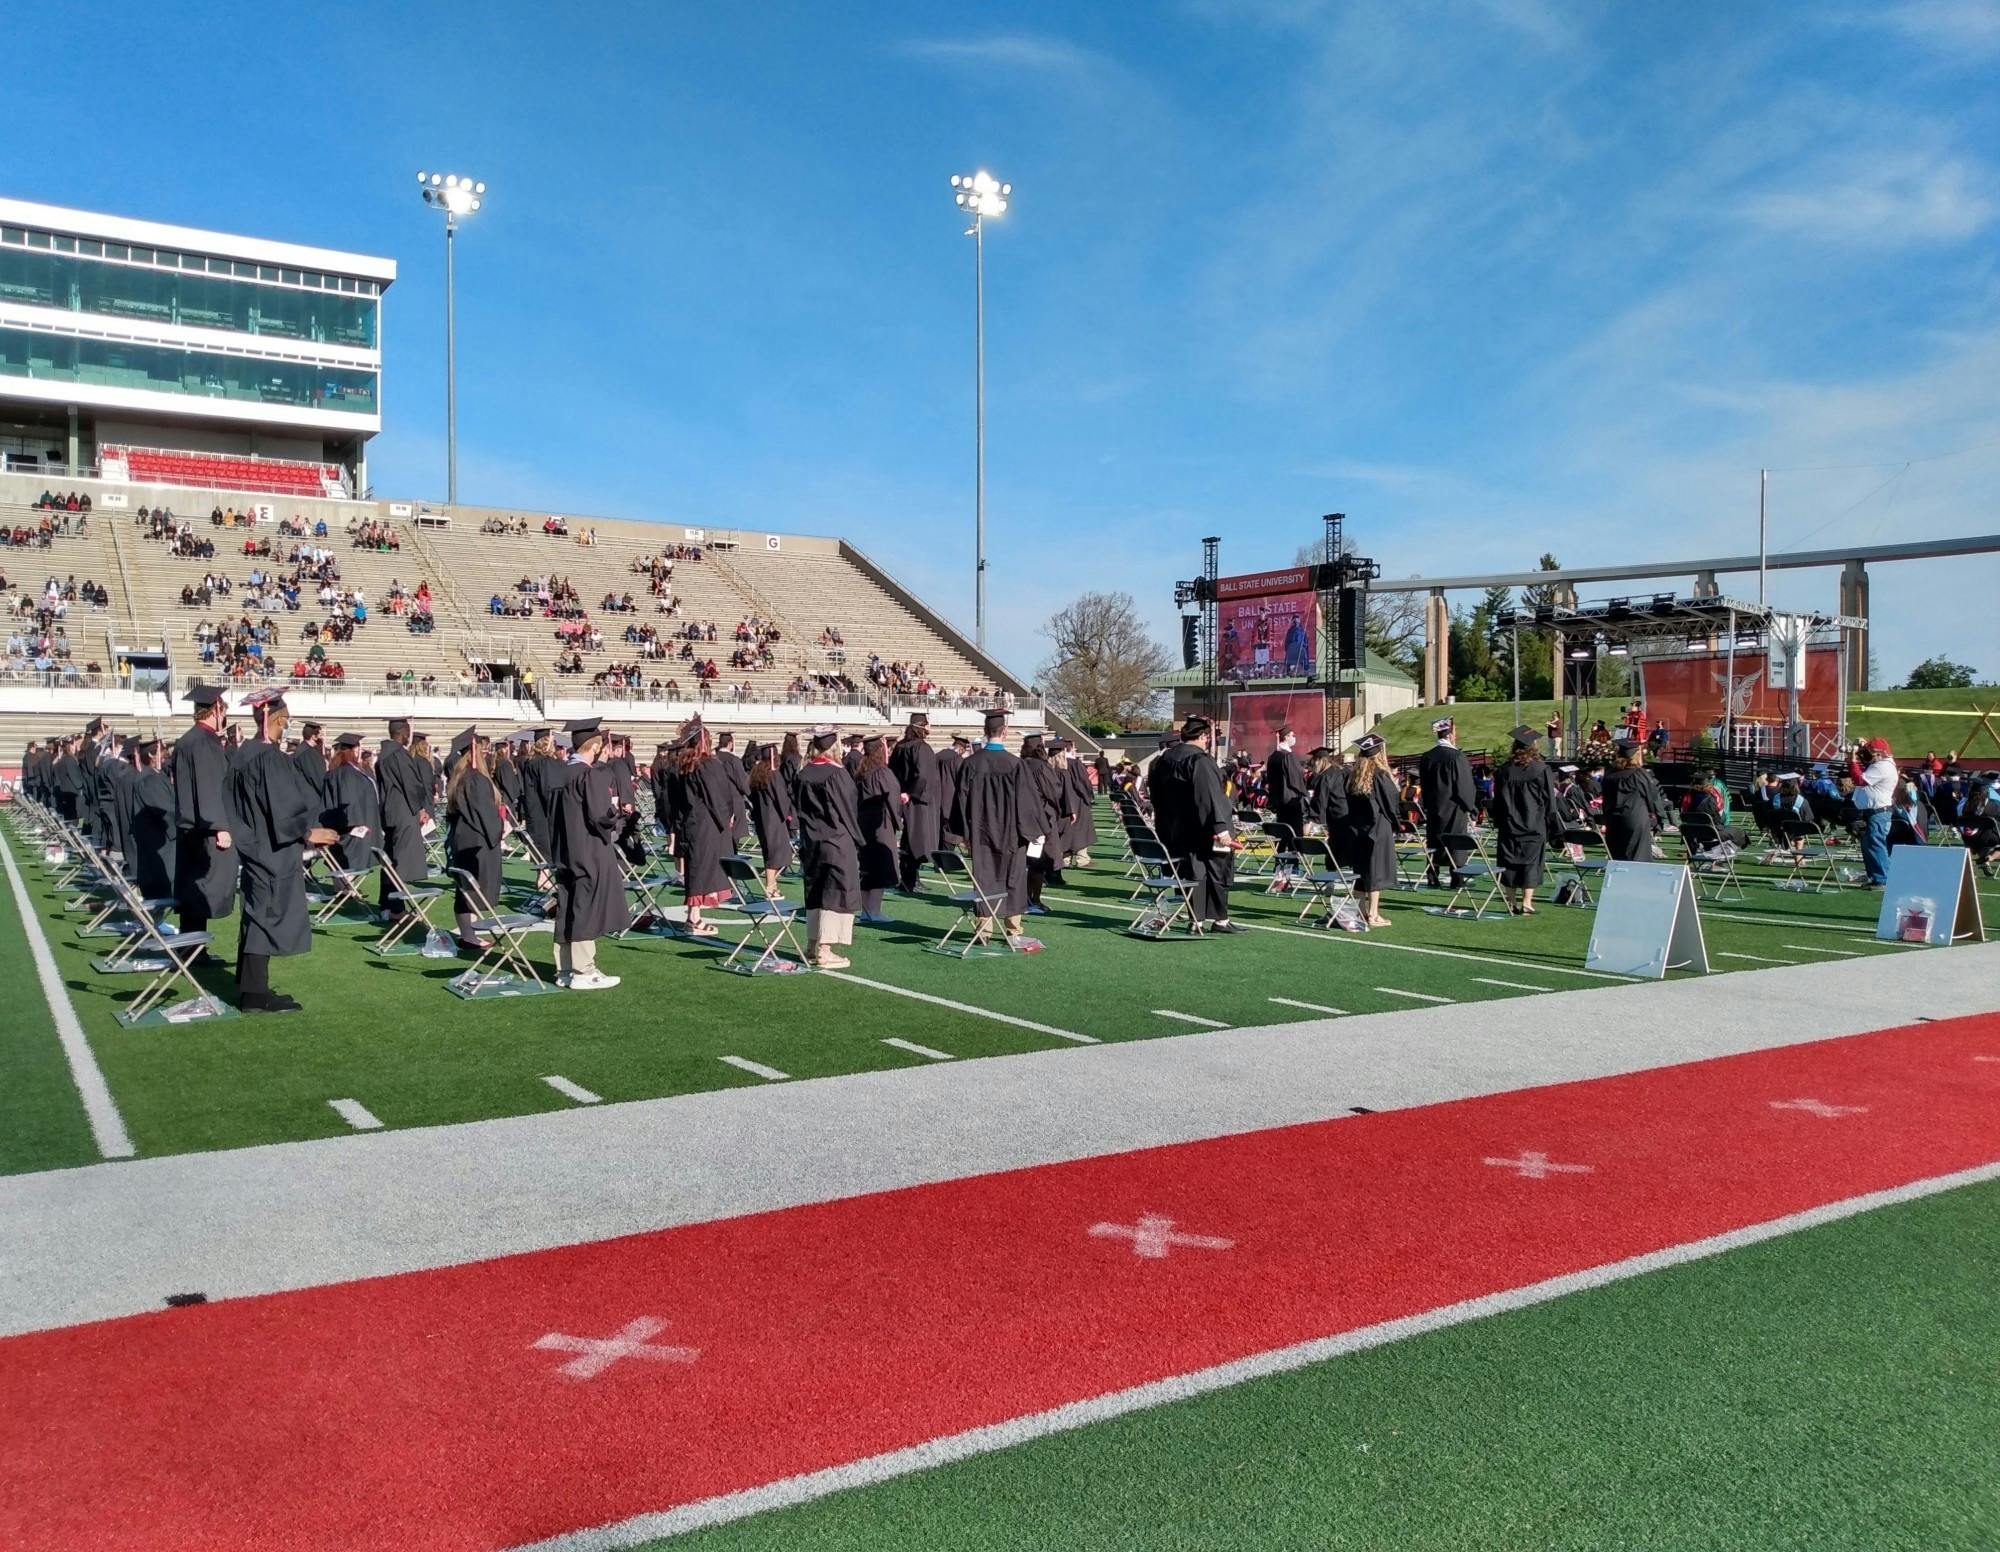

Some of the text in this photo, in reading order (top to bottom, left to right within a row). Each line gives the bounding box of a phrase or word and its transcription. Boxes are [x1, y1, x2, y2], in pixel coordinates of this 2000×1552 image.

[260, 506, 269, 520] E
[768, 537, 778, 549] G
[1220, 574, 1305, 592] BALL STATE UNIVERSITY
[1267, 602, 1297, 614] STATE
